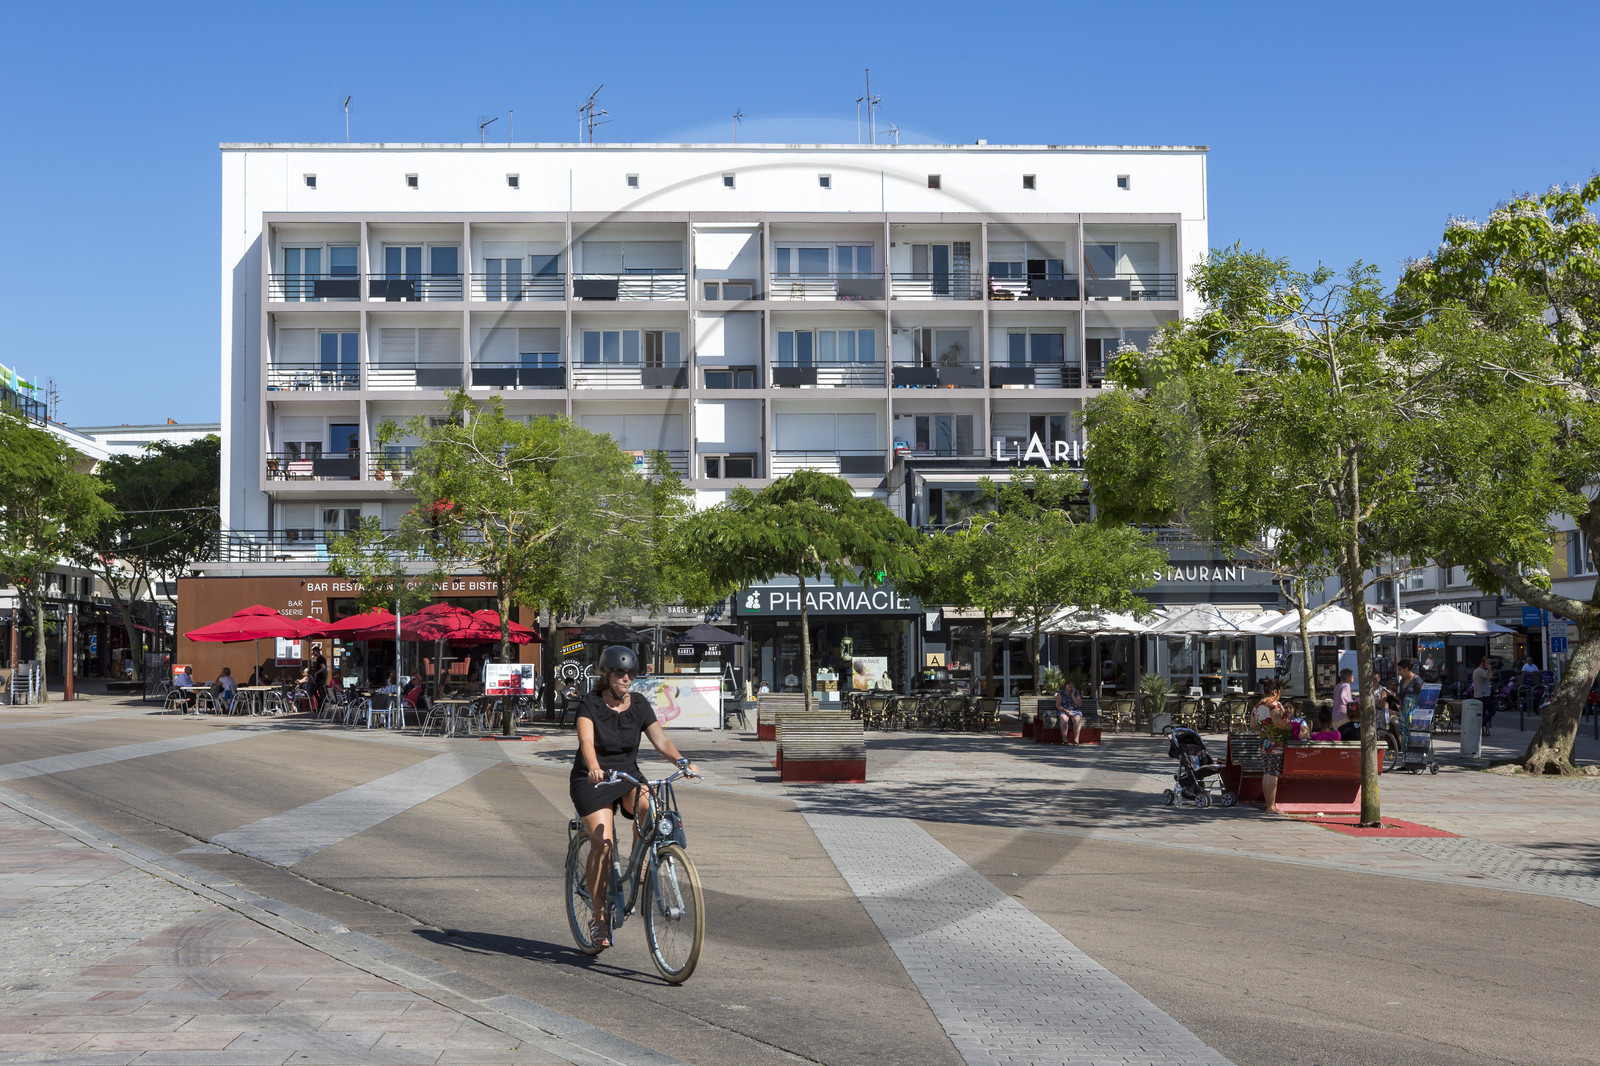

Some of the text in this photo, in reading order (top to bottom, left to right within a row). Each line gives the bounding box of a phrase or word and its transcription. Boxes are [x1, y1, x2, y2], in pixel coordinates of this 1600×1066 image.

[1130, 565, 1248, 581] STAURANT
[307, 583, 394, 592] BAR RESTAN
[451, 582, 466, 591] DE
[469, 581, 506, 591] BISTR
[769, 590, 911, 611] PHARMACIE
[667, 606, 689, 614] BAGEL
[930, 655, 941, 666] A
[1260, 652, 1271, 664] A
